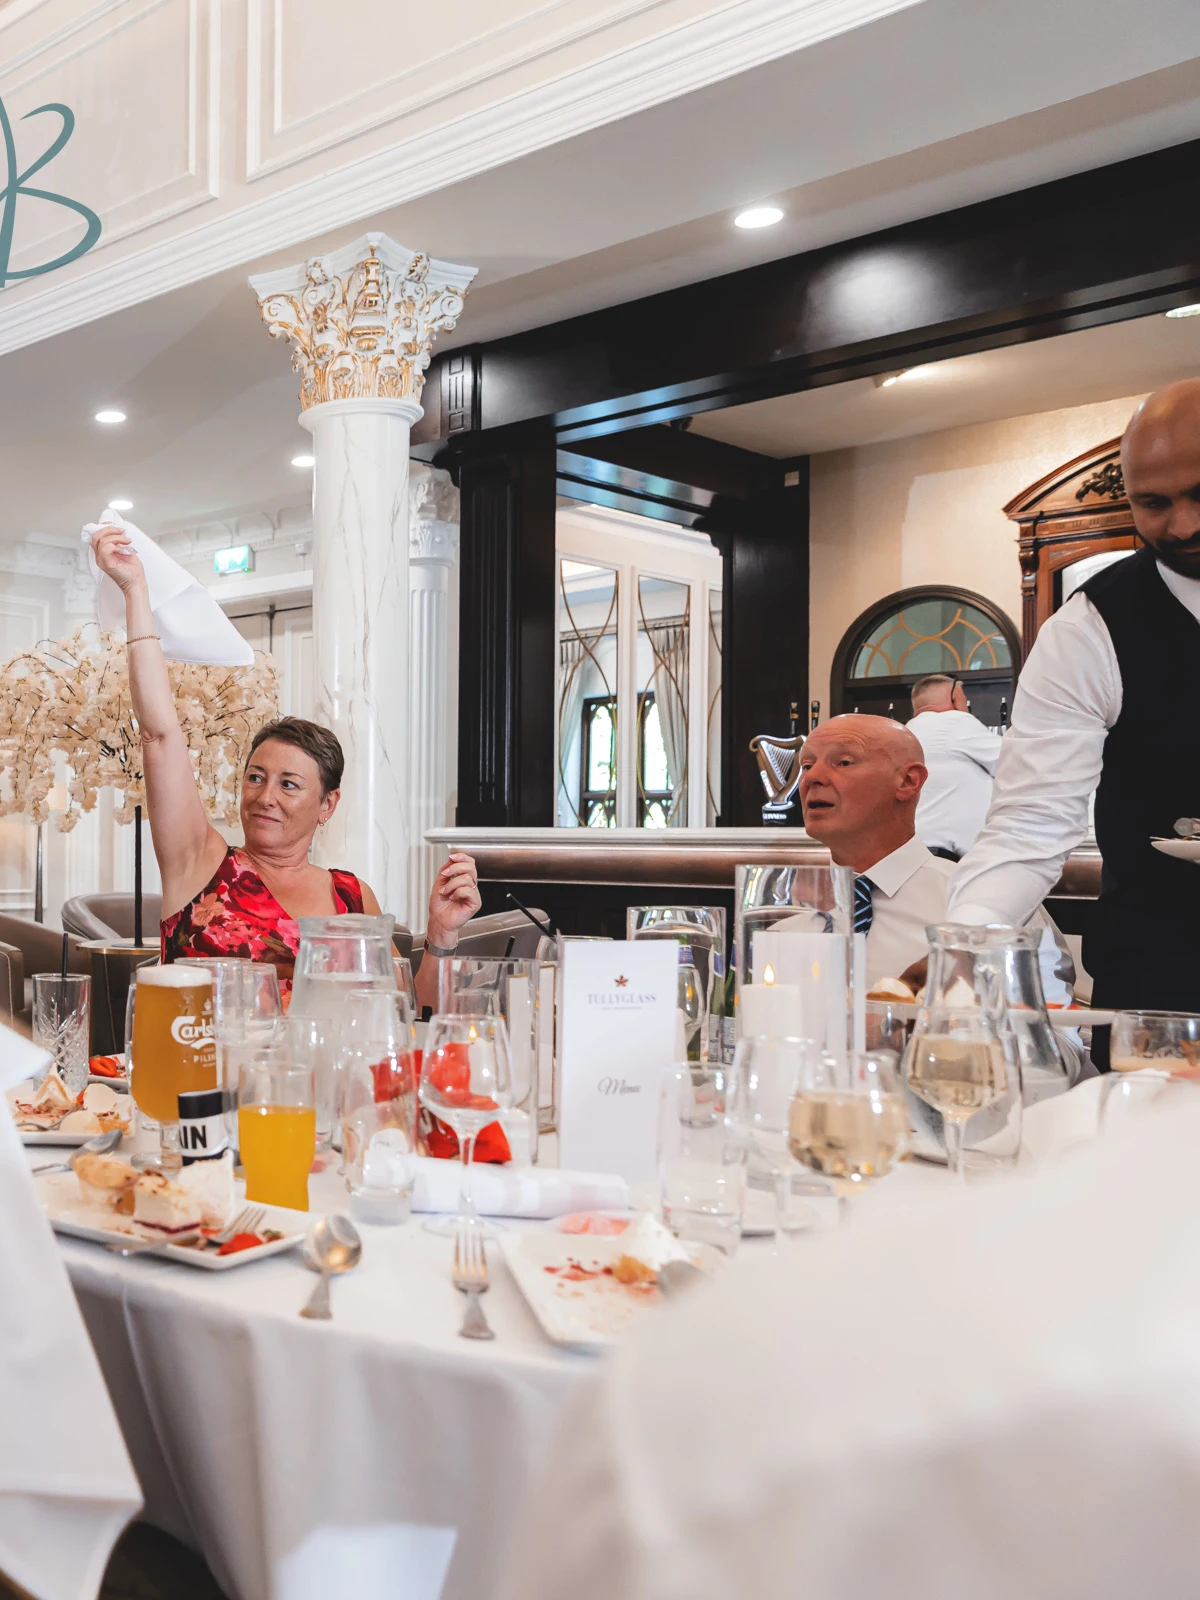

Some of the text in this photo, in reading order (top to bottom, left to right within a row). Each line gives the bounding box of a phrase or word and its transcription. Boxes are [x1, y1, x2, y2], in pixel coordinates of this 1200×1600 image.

[587, 993, 656, 1004] TULLYGLASS
[597, 1077, 641, 1095] Menu
[179, 1125, 207, 1149] IN
